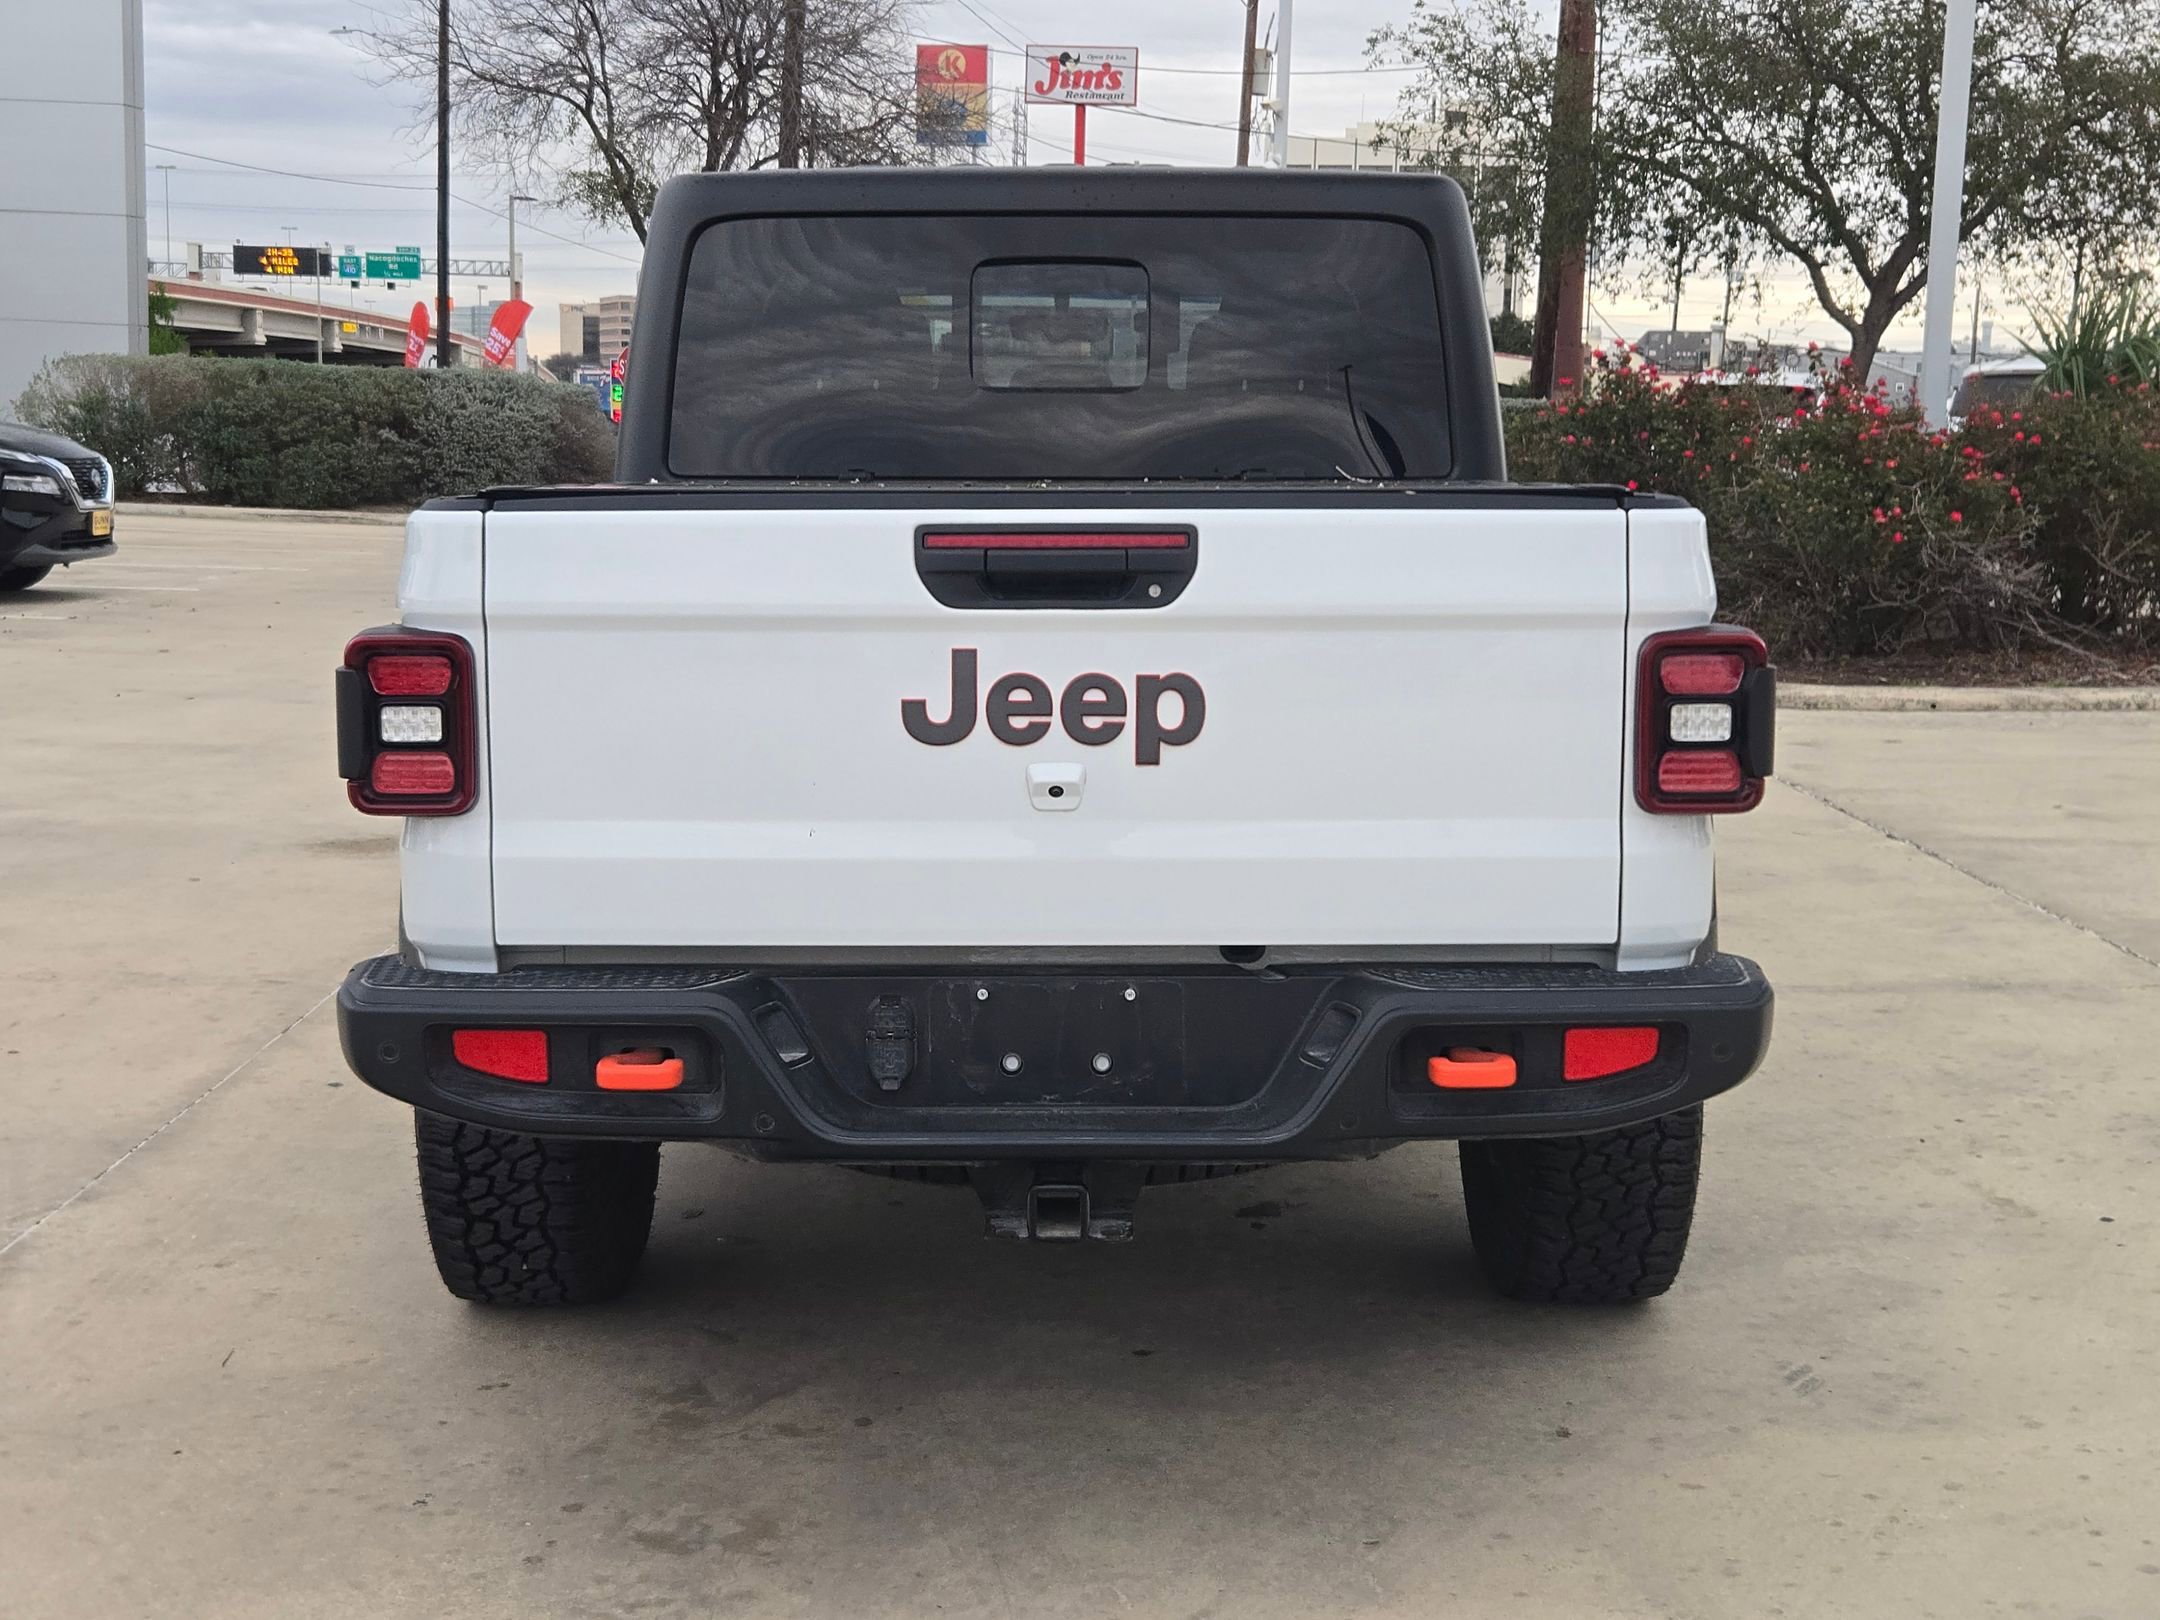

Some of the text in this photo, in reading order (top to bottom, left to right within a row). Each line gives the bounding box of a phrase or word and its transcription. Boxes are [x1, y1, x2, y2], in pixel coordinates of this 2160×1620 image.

[945, 55, 964, 79] K
[1087, 54, 1103, 62] Open
[1034, 55, 1124, 96] Jim's
[1065, 91, 1126, 101] Restaurant
[490, 326, 512, 348] Save
[901, 648, 1206, 766] Jeep
